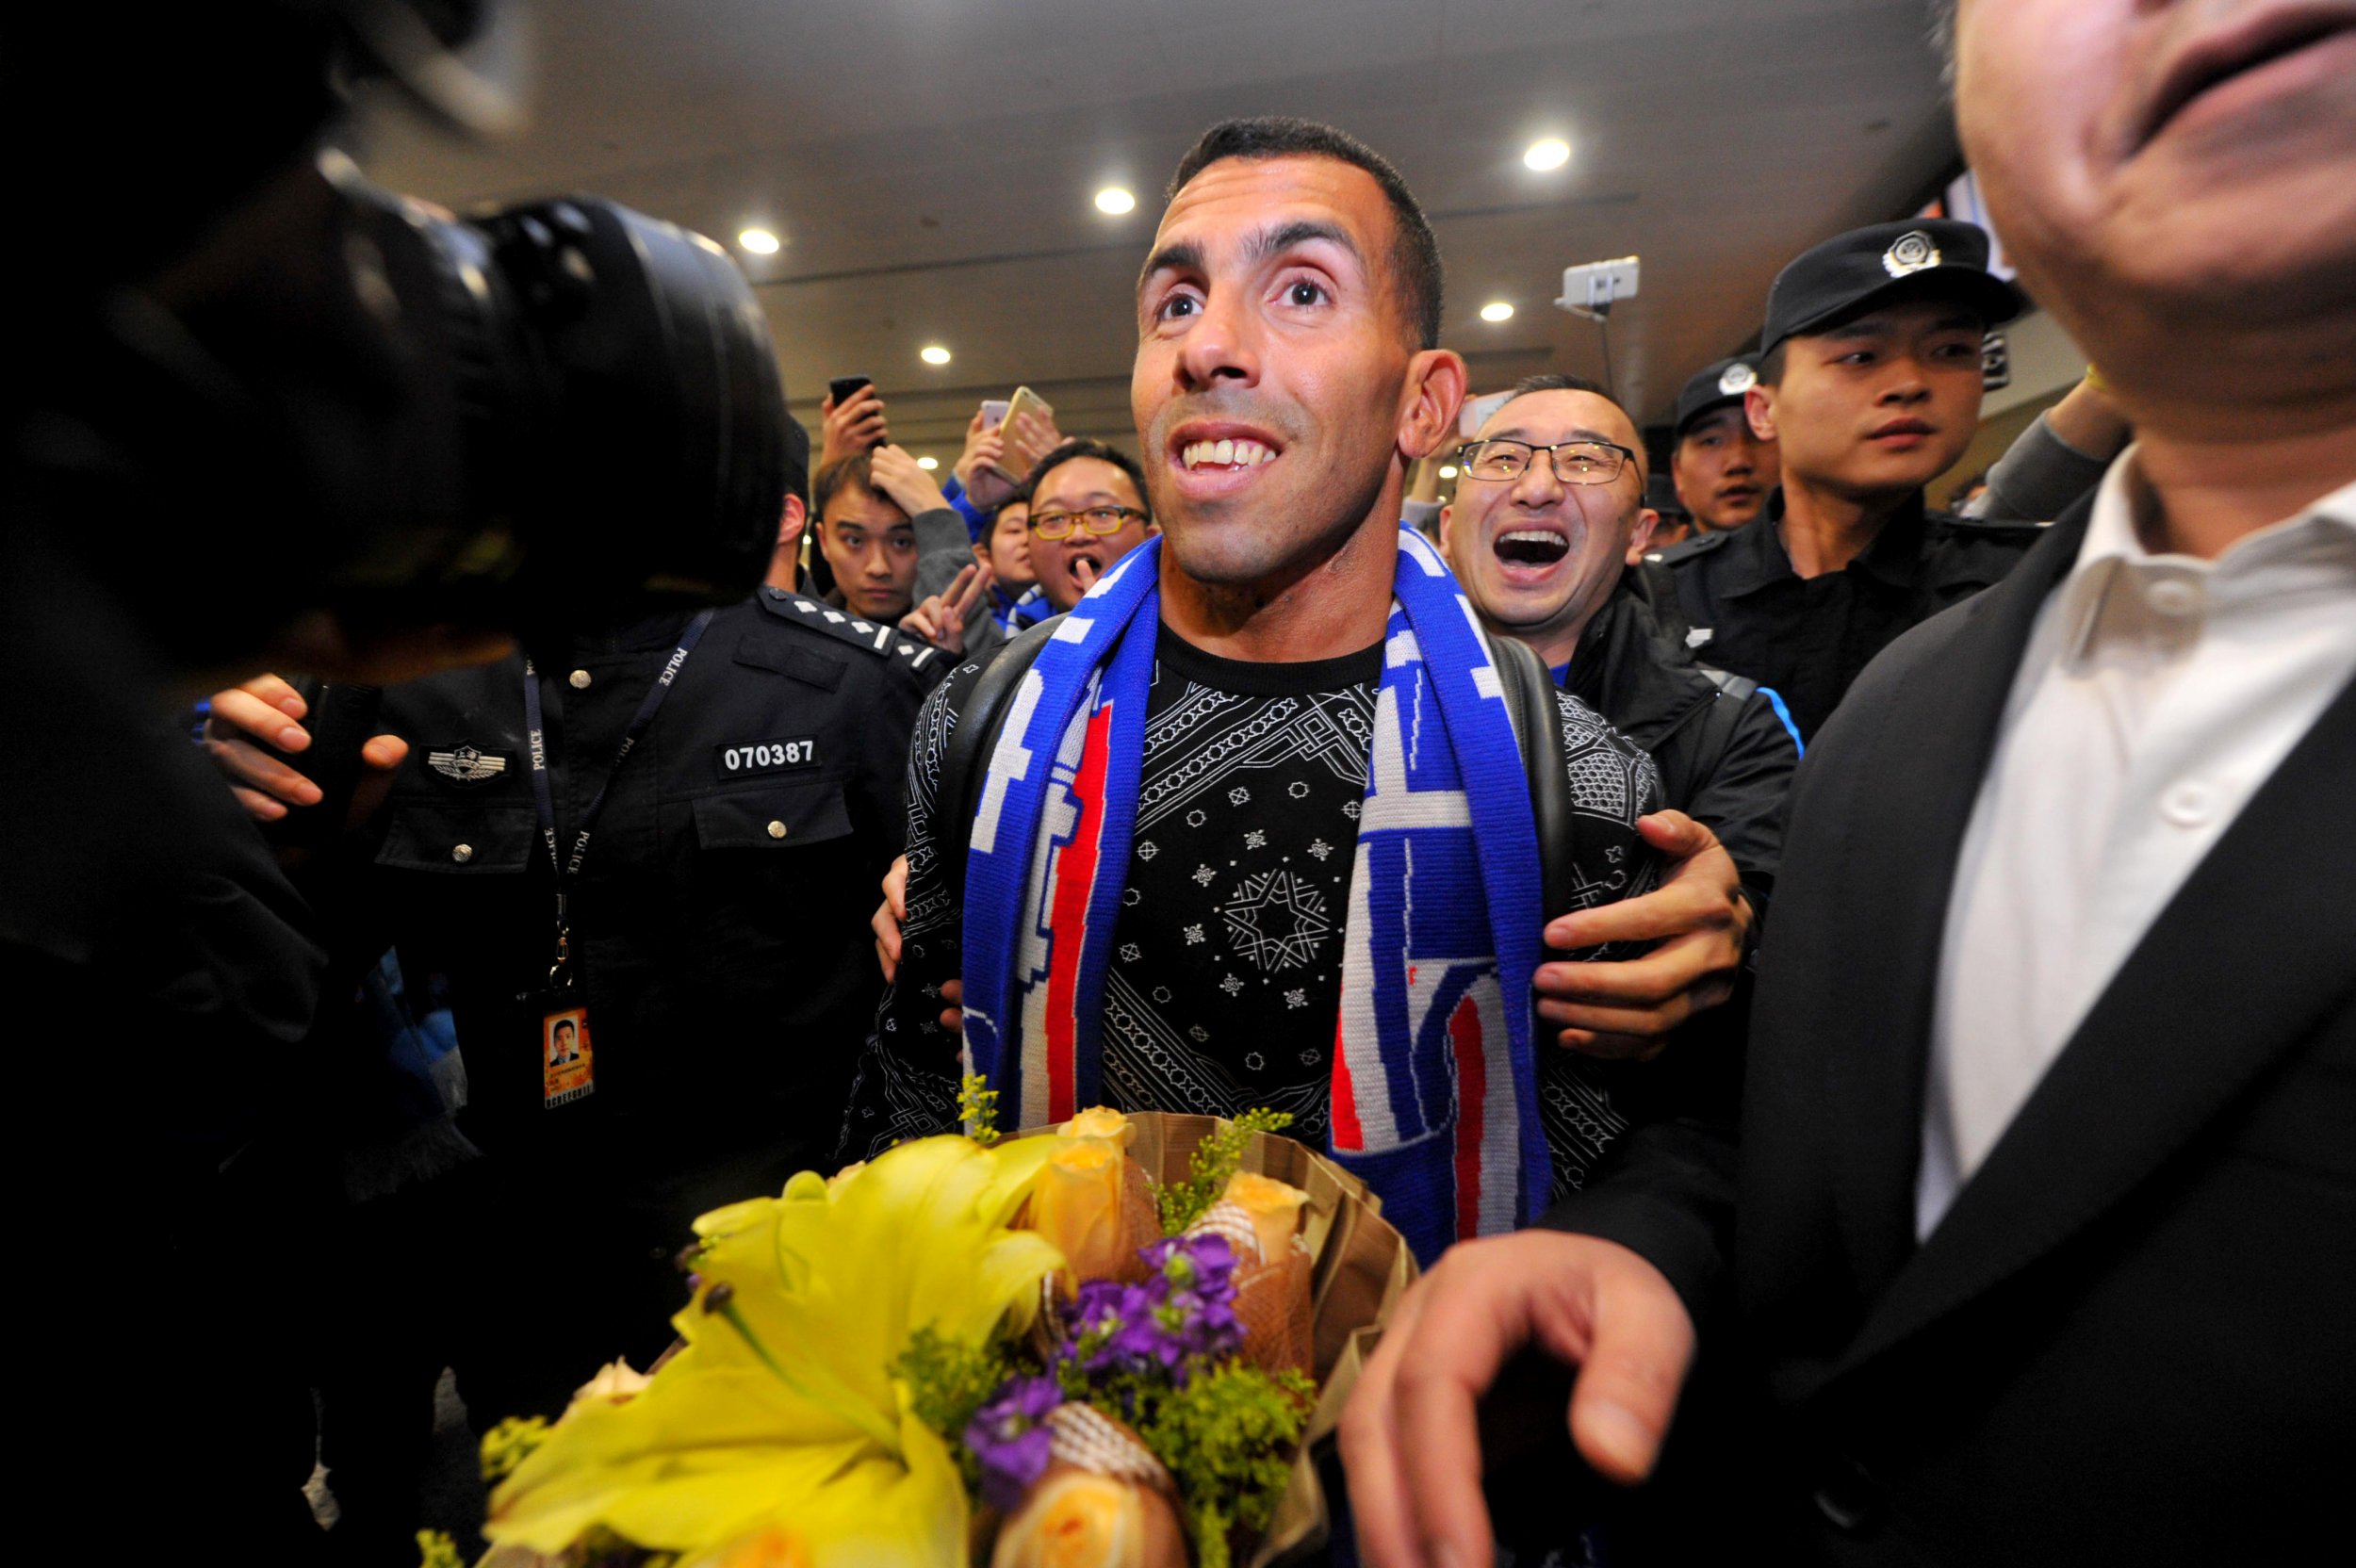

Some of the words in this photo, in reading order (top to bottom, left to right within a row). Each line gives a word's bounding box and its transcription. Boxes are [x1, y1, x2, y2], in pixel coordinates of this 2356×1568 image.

[659, 646, 689, 687] POLICE
[529, 728, 546, 771] POLICE
[725, 740, 813, 771] 070387
[566, 830, 591, 874] POLICE
